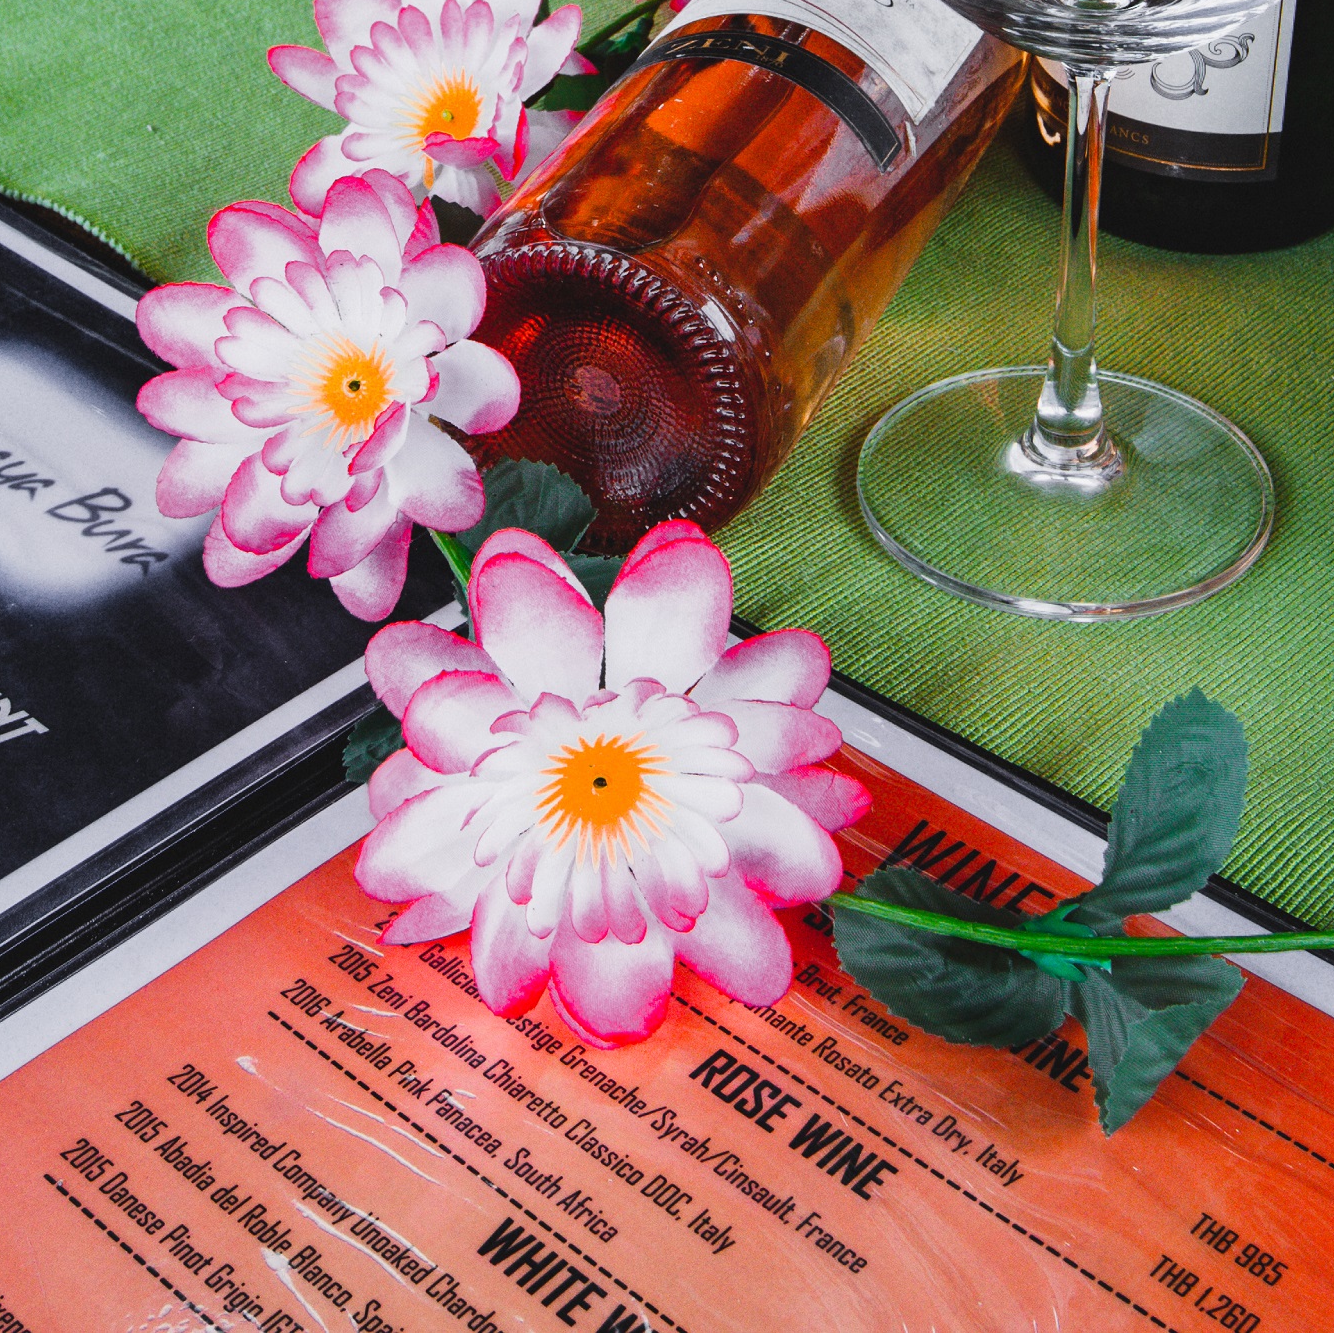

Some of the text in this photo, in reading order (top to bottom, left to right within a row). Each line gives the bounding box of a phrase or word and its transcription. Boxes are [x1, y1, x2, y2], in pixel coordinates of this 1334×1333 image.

[666, 38, 791, 63] ZENI
[1110, 125, 1150, 145] ANCS
[45, 487, 169, 576] Bura
[795, 964, 910, 1046] Brut, France
[1009, 1032, 1092, 1094] INE
[280, 978, 619, 1244] 2016 Arabella Pink Panacea, South Africa
[328, 944, 736, 1255] 2015 Zeni Bardolina Chiaretto Classico DOC, Italy
[506, 1015, 564, 1055] estige
[795, 1211, 868, 1274] France
[688, 1048, 900, 1202] ROSE WINE
[812, 1036, 881, 1090] Rosato
[879, 1080, 934, 1126] Extra
[931, 1114, 975, 1157] Dry,
[974, 1143, 1026, 1187] Italy
[59, 1138, 115, 1183] 2015
[99, 1171, 167, 1236] Danese
[159, 1223, 213, 1276] Pinot
[204, 1263, 265, 1329] Grigio
[114, 1100, 169, 1143] 2015
[153, 1135, 216, 1192] Abadia
[209, 1184, 254, 1216] del
[236, 1203, 293, 1254] Roble
[287, 1244, 353, 1313] Blanco,
[167, 1063, 219, 1105] 2014
[204, 1094, 288, 1161] Inspired
[271, 1149, 356, 1226] Company
[350, 1212, 438, 1284] Unoaked
[476, 1216, 608, 1328] WHITE
[1149, 1254, 1200, 1298] THB
[1190, 1211, 1289, 1287] THB 985
